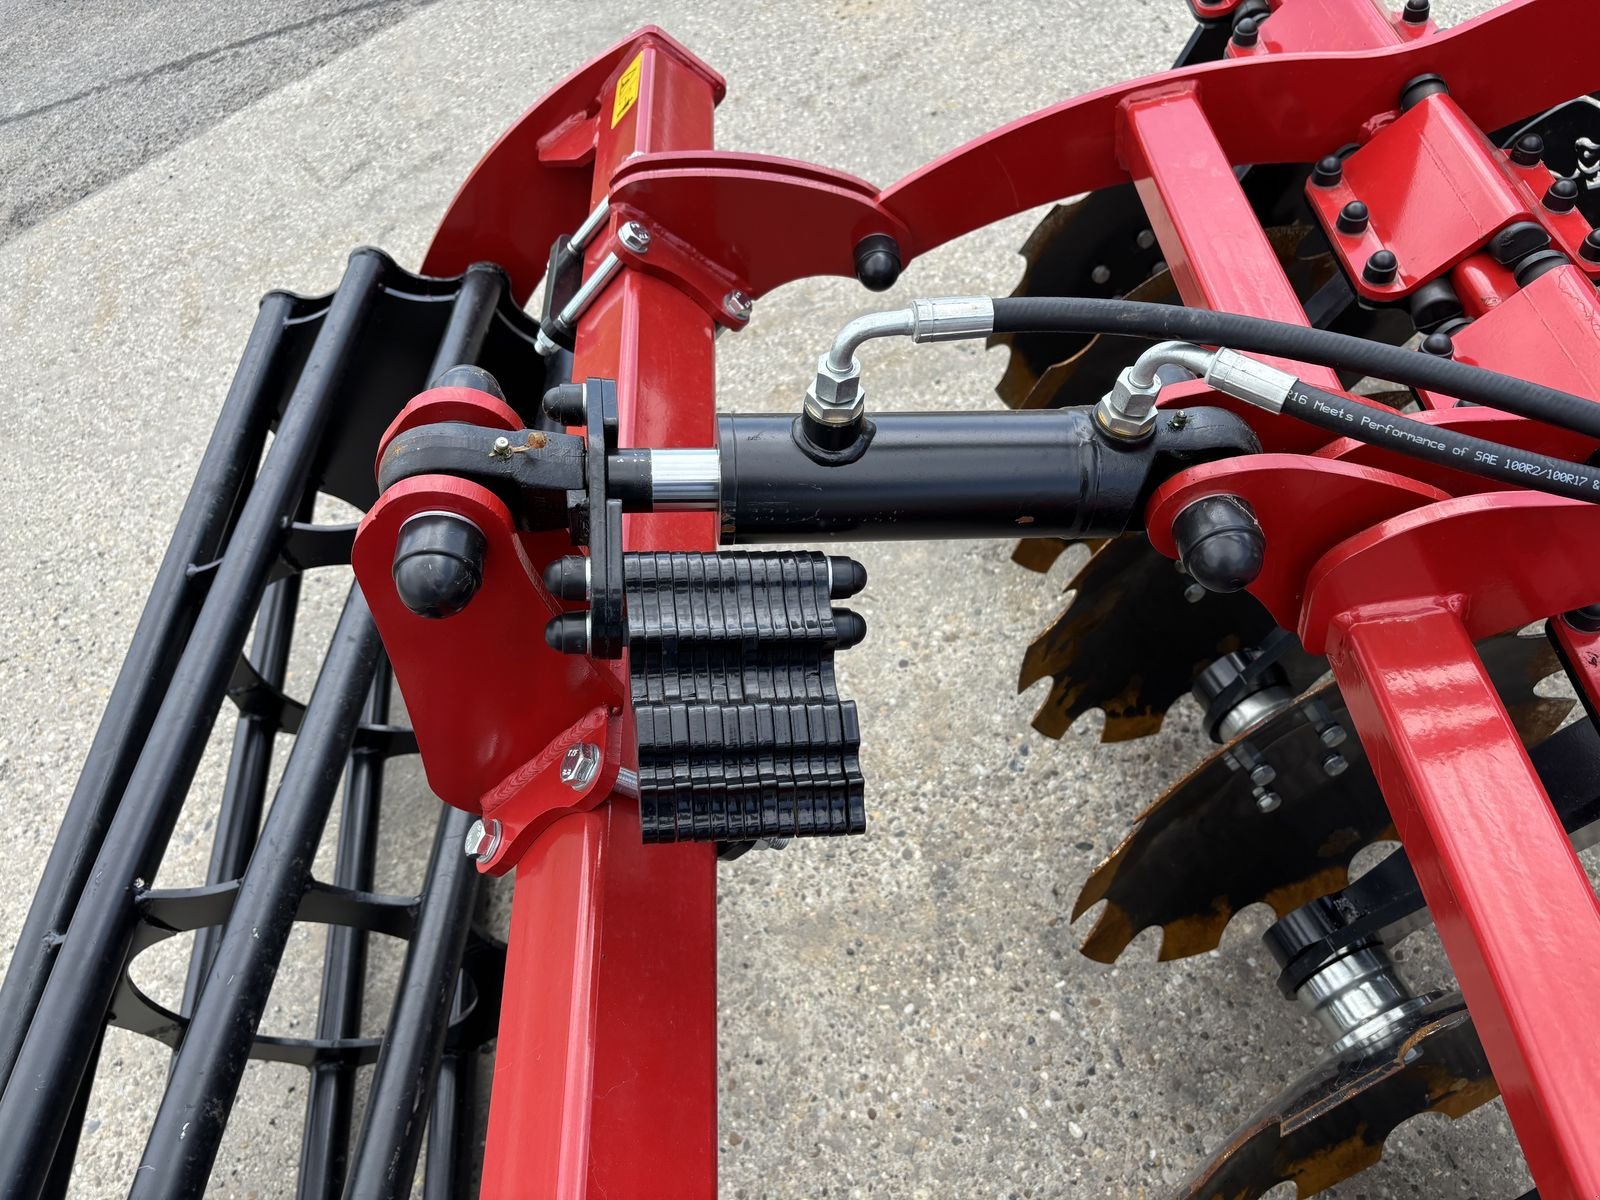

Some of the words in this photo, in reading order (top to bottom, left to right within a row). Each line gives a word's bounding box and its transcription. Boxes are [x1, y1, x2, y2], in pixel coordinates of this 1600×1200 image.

[1313, 399, 1354, 422] Meets
[1360, 415, 1447, 451] Performance
[1452, 445, 1469, 457] of
[1473, 450, 1499, 466] SAE
[1504, 458, 1588, 487] 100R2/100R17
